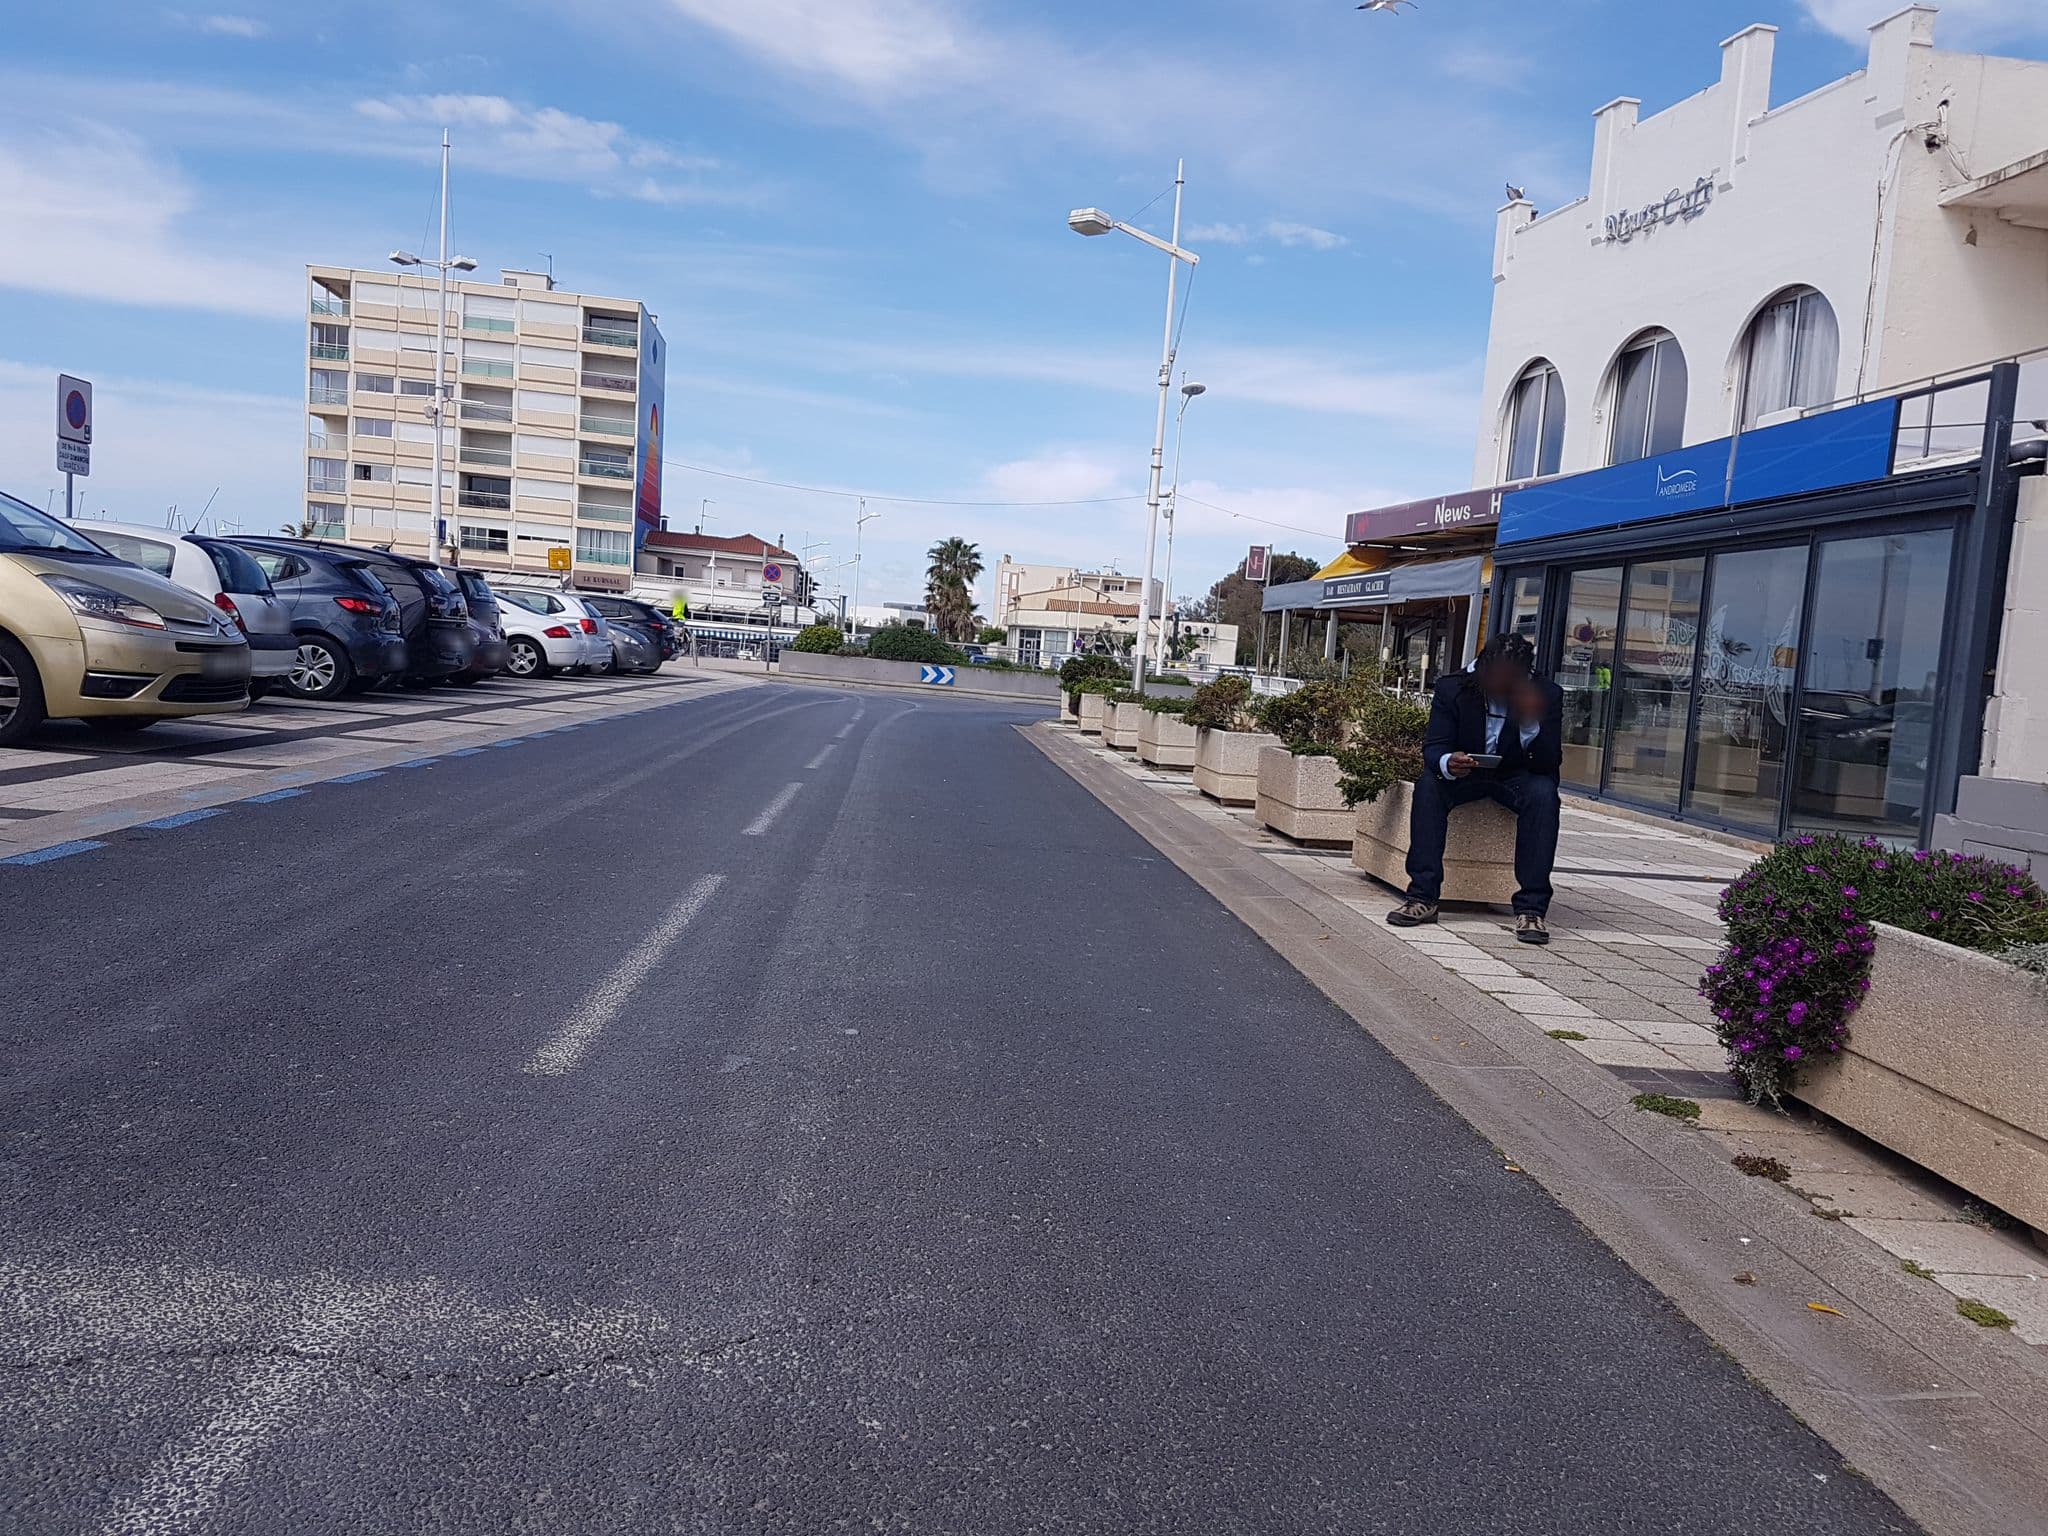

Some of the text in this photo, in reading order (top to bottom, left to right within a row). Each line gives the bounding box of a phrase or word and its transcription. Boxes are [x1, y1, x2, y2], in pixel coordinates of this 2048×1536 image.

[1659, 480, 1697, 497] ANDROMEDE
[1434, 503, 1471, 525] News
[1326, 580, 1385, 596] BAR RESTAURANT GLACIER
